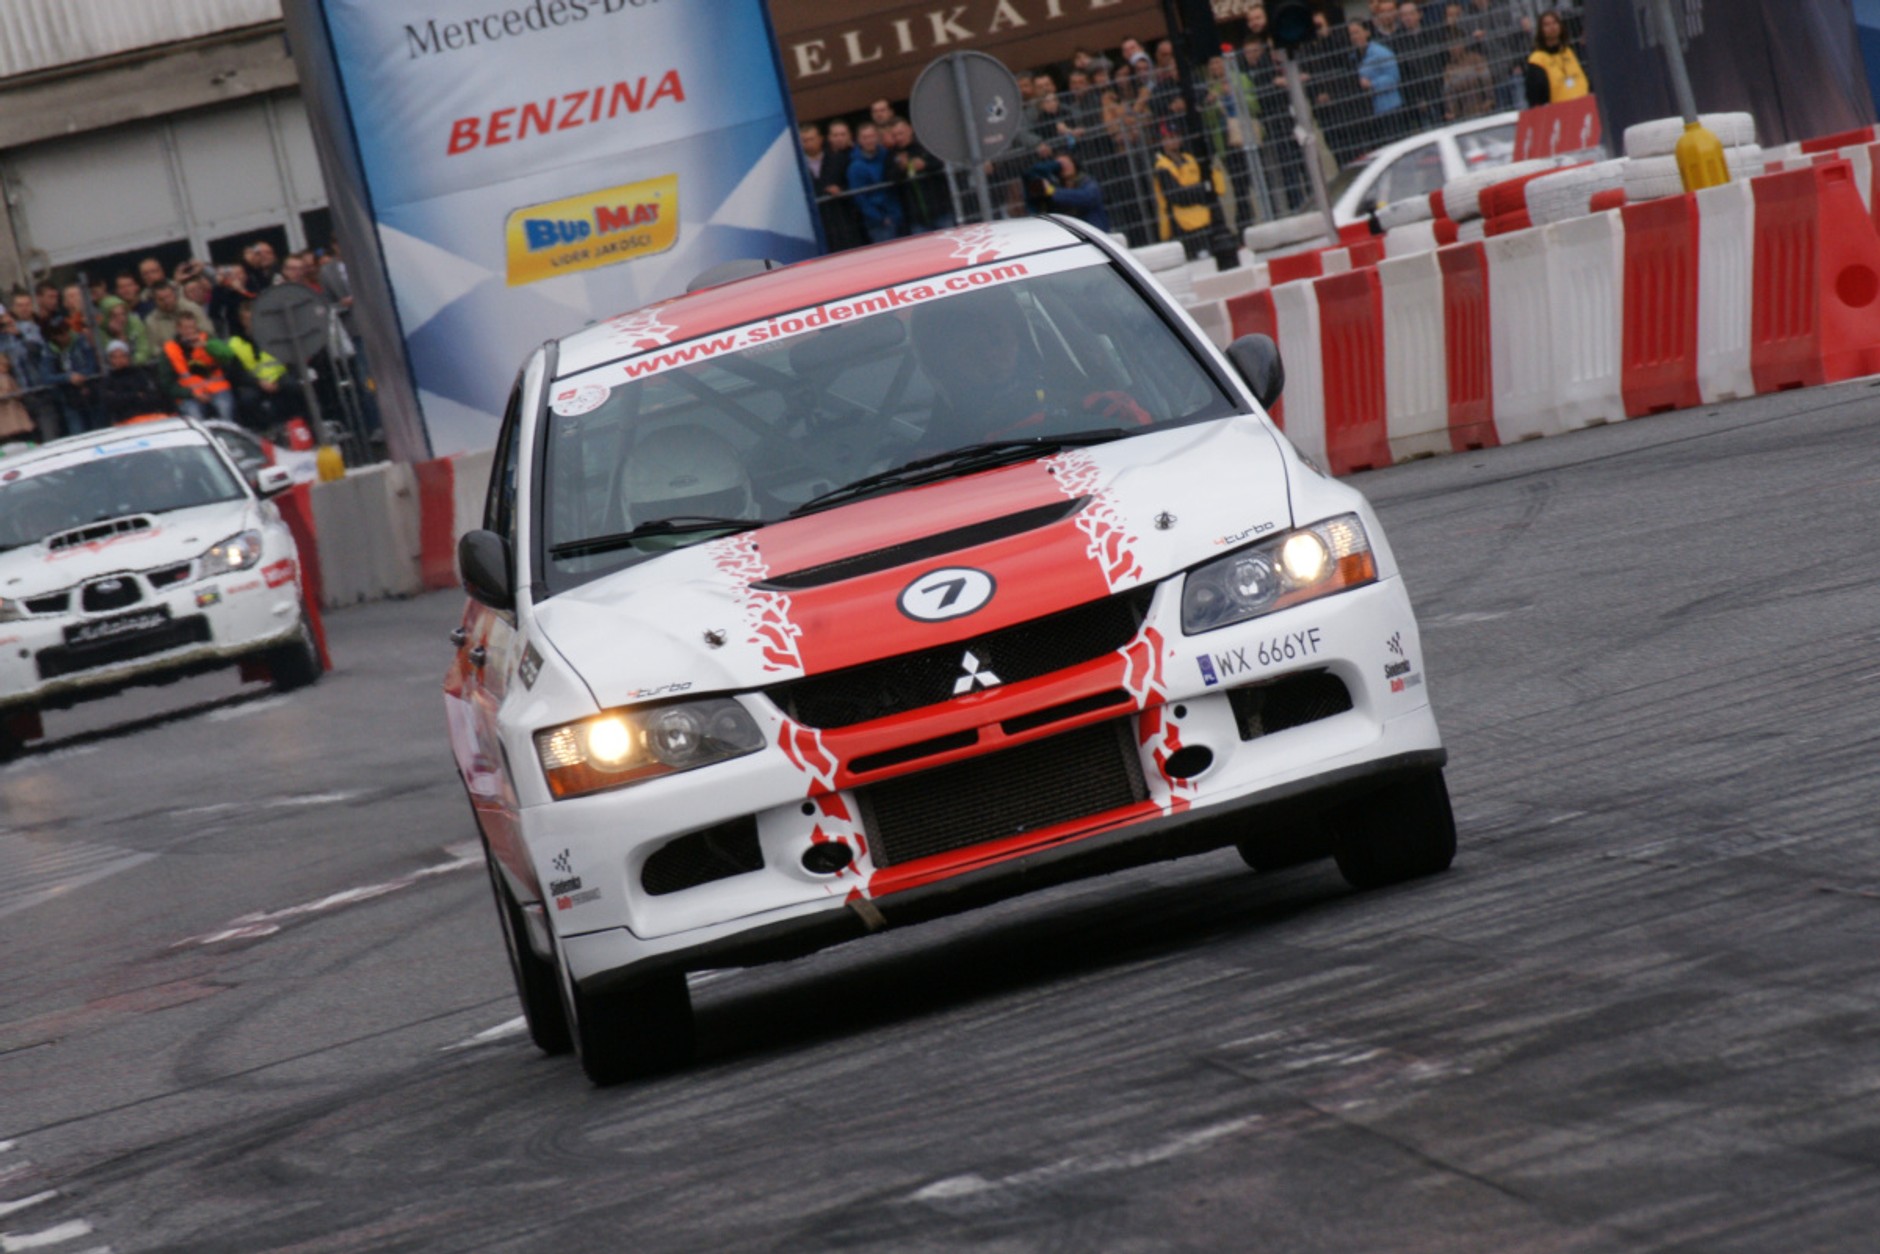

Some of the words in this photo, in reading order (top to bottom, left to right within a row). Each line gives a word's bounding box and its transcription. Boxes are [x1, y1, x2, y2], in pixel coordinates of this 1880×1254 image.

[446, 69, 686, 156] BENZINA
[523, 219, 591, 252] BUD
[594, 203, 660, 235] MAT
[550, 249, 590, 267] LIDER
[623, 263, 1029, 378] www.siodemka.com
[921, 577, 967, 610] 7
[1216, 647, 1252, 678] WX
[1258, 628, 1321, 667] 666YF
